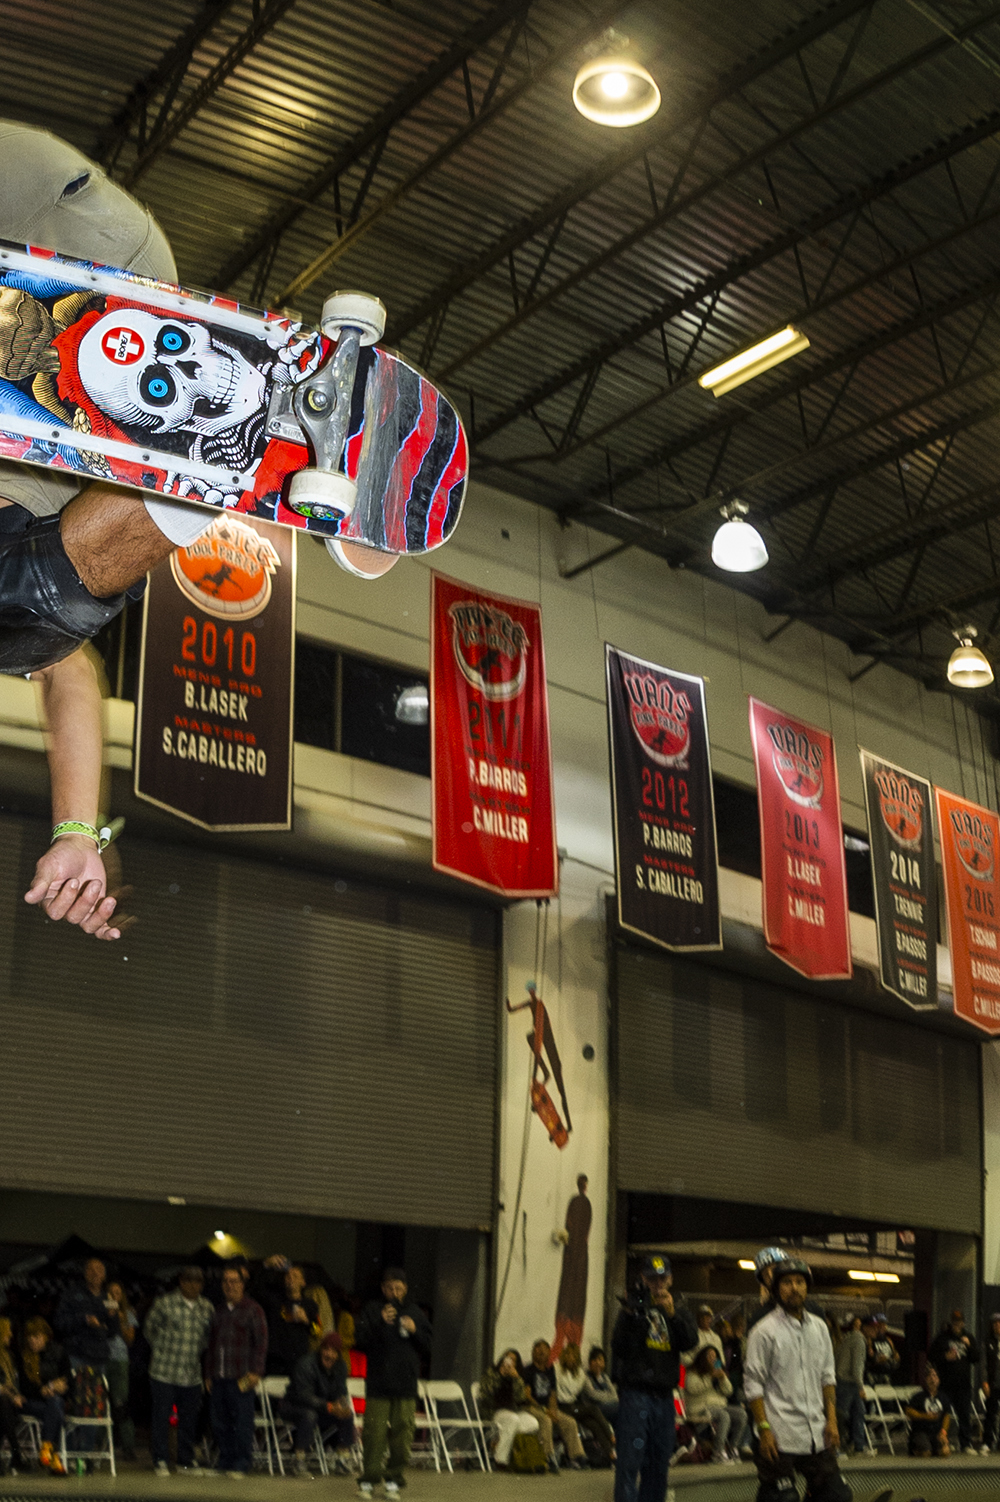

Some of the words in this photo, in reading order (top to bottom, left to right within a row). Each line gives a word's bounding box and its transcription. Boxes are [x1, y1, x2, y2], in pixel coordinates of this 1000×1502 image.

[117, 334, 129, 358] BONES
[182, 616, 256, 677] 2010
[185, 680, 248, 722] B.LASEK
[625, 675, 691, 721] VANS
[469, 700, 522, 752] 2011
[162, 726, 267, 777] S.CABALLERO
[768, 724, 824, 769] VANS
[468, 757, 527, 797] P.BARROS
[642, 767, 690, 818] 2012
[875, 773, 922, 813] VANS
[474, 805, 529, 844] C.MILLER
[642, 822, 692, 858] P.BARROS
[785, 809, 819, 849] 2013
[890, 850, 920, 890] 2014
[965, 884, 995, 917] 2015
